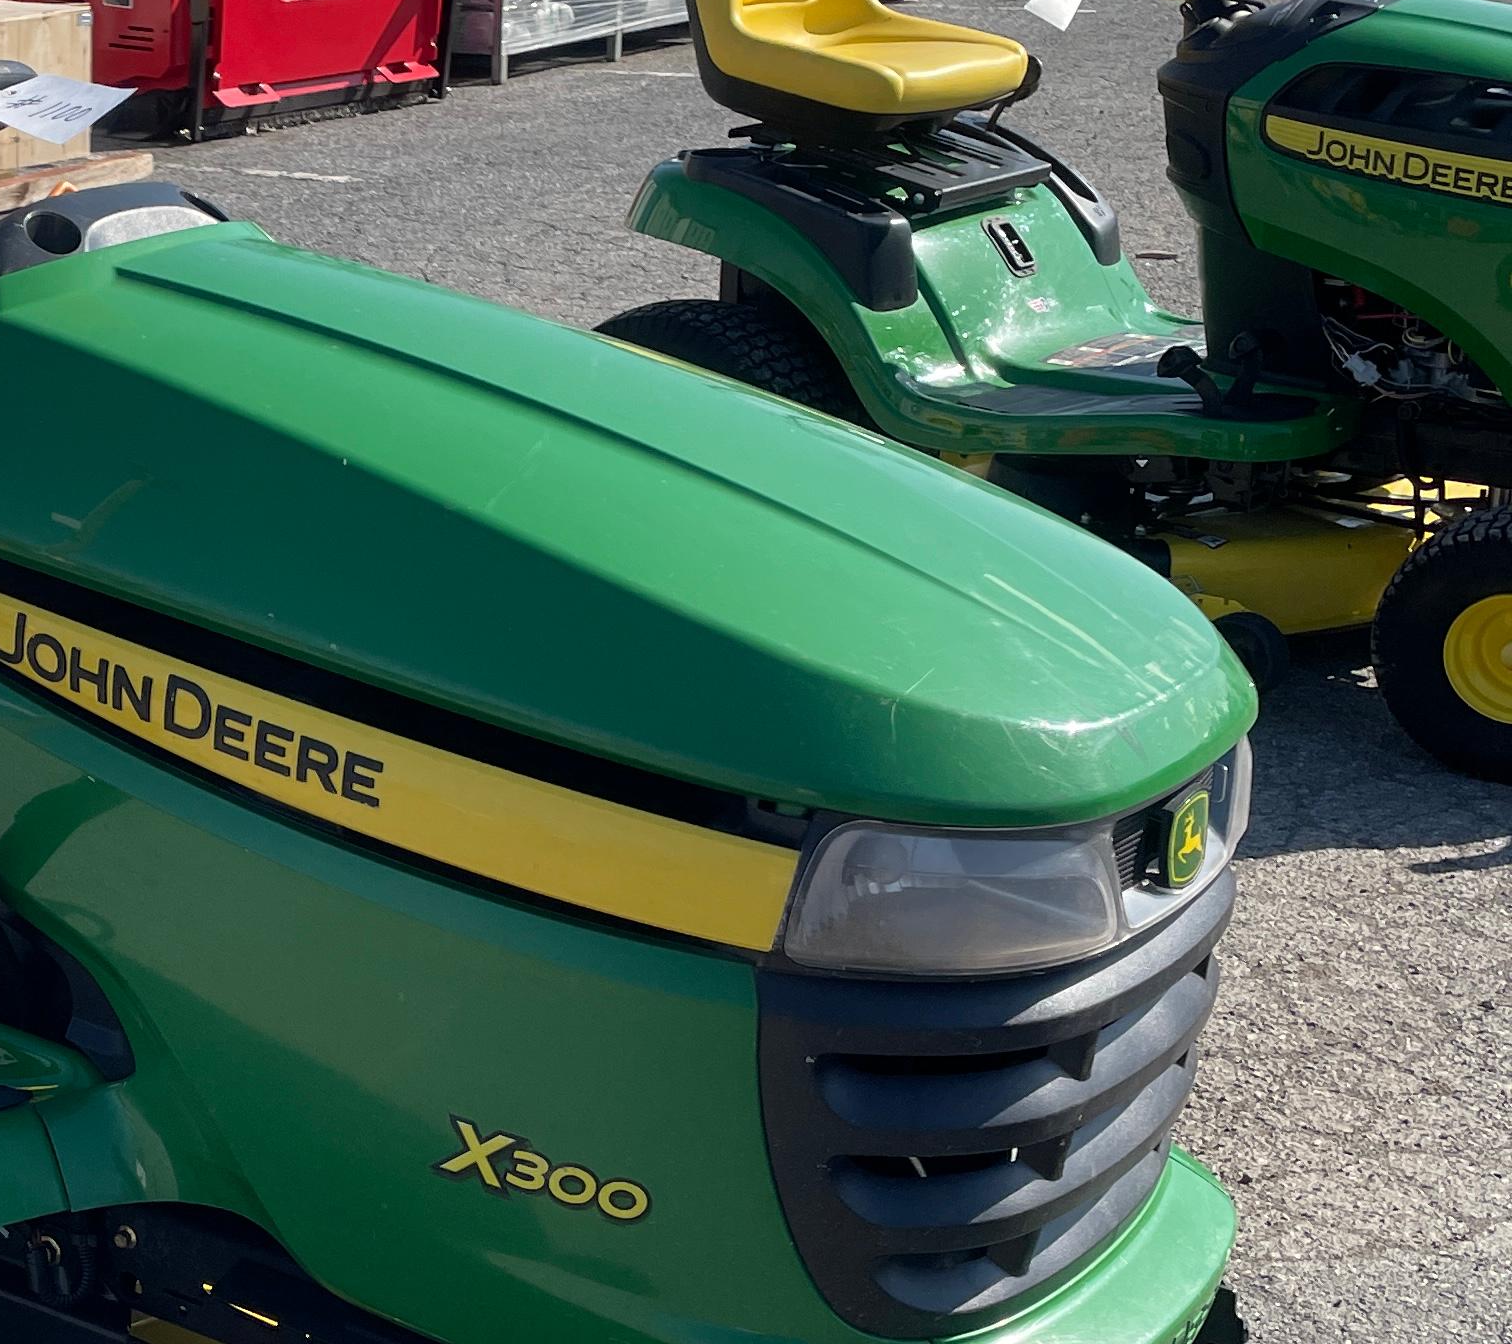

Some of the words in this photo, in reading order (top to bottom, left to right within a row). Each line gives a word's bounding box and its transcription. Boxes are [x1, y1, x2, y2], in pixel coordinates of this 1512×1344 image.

[1306, 130, 1395, 176] JOHN
[163, 673, 384, 808] DEERE
[437, 1118, 650, 1221] X300
